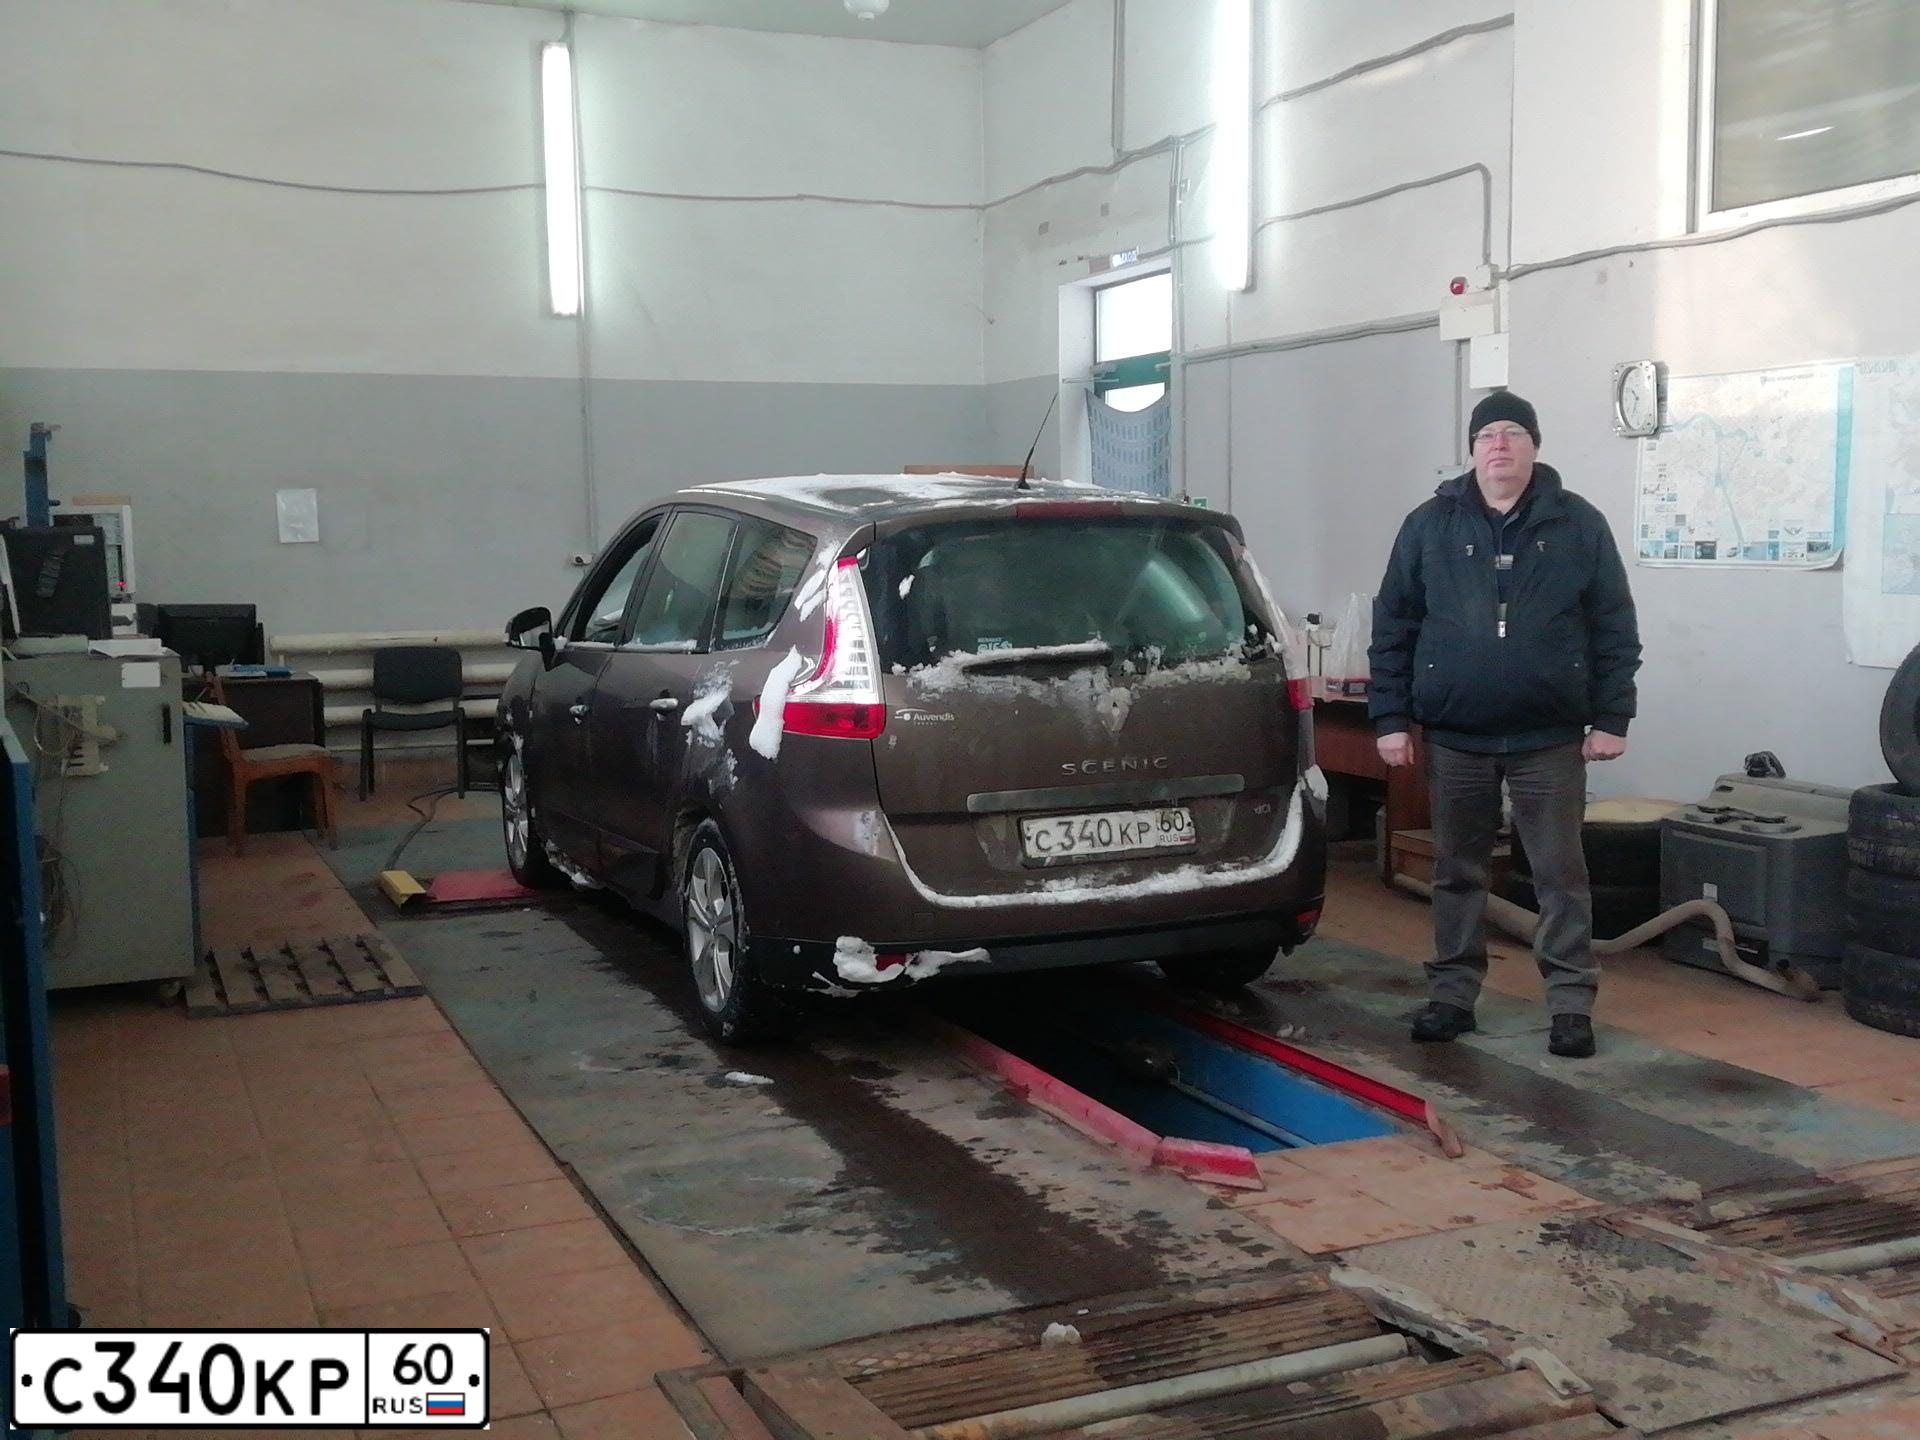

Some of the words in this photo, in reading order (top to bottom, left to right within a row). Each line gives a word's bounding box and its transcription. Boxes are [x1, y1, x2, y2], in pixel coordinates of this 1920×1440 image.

[913, 712, 955, 721] Auvendis
[1061, 757, 1169, 776] SCENIC
[1159, 810, 1185, 833] 60
[1159, 834, 1180, 844] RUS
